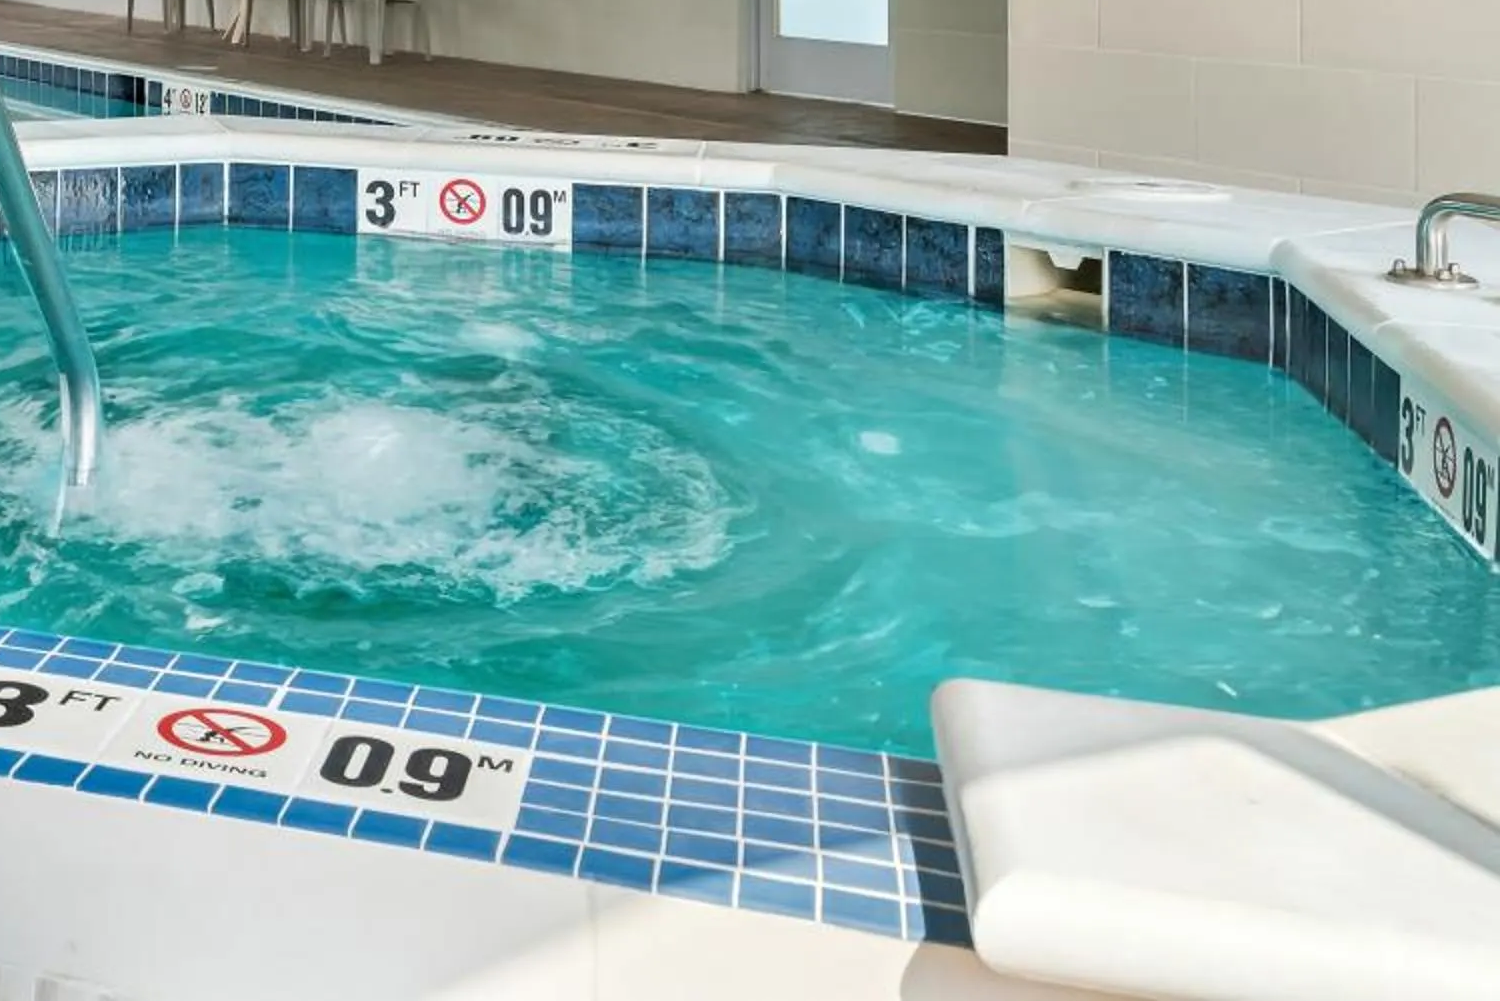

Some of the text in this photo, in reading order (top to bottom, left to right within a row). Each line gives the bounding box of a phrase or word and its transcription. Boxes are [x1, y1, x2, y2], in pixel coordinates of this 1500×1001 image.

[365, 180, 396, 228] 3
[399, 181, 420, 197] FT
[1401, 397, 1415, 476] 3
[59, 690, 122, 712] FT
[319, 735, 473, 802] 0.9
[476, 755, 514, 774] M
[133, 750, 267, 778] NO DIVING
